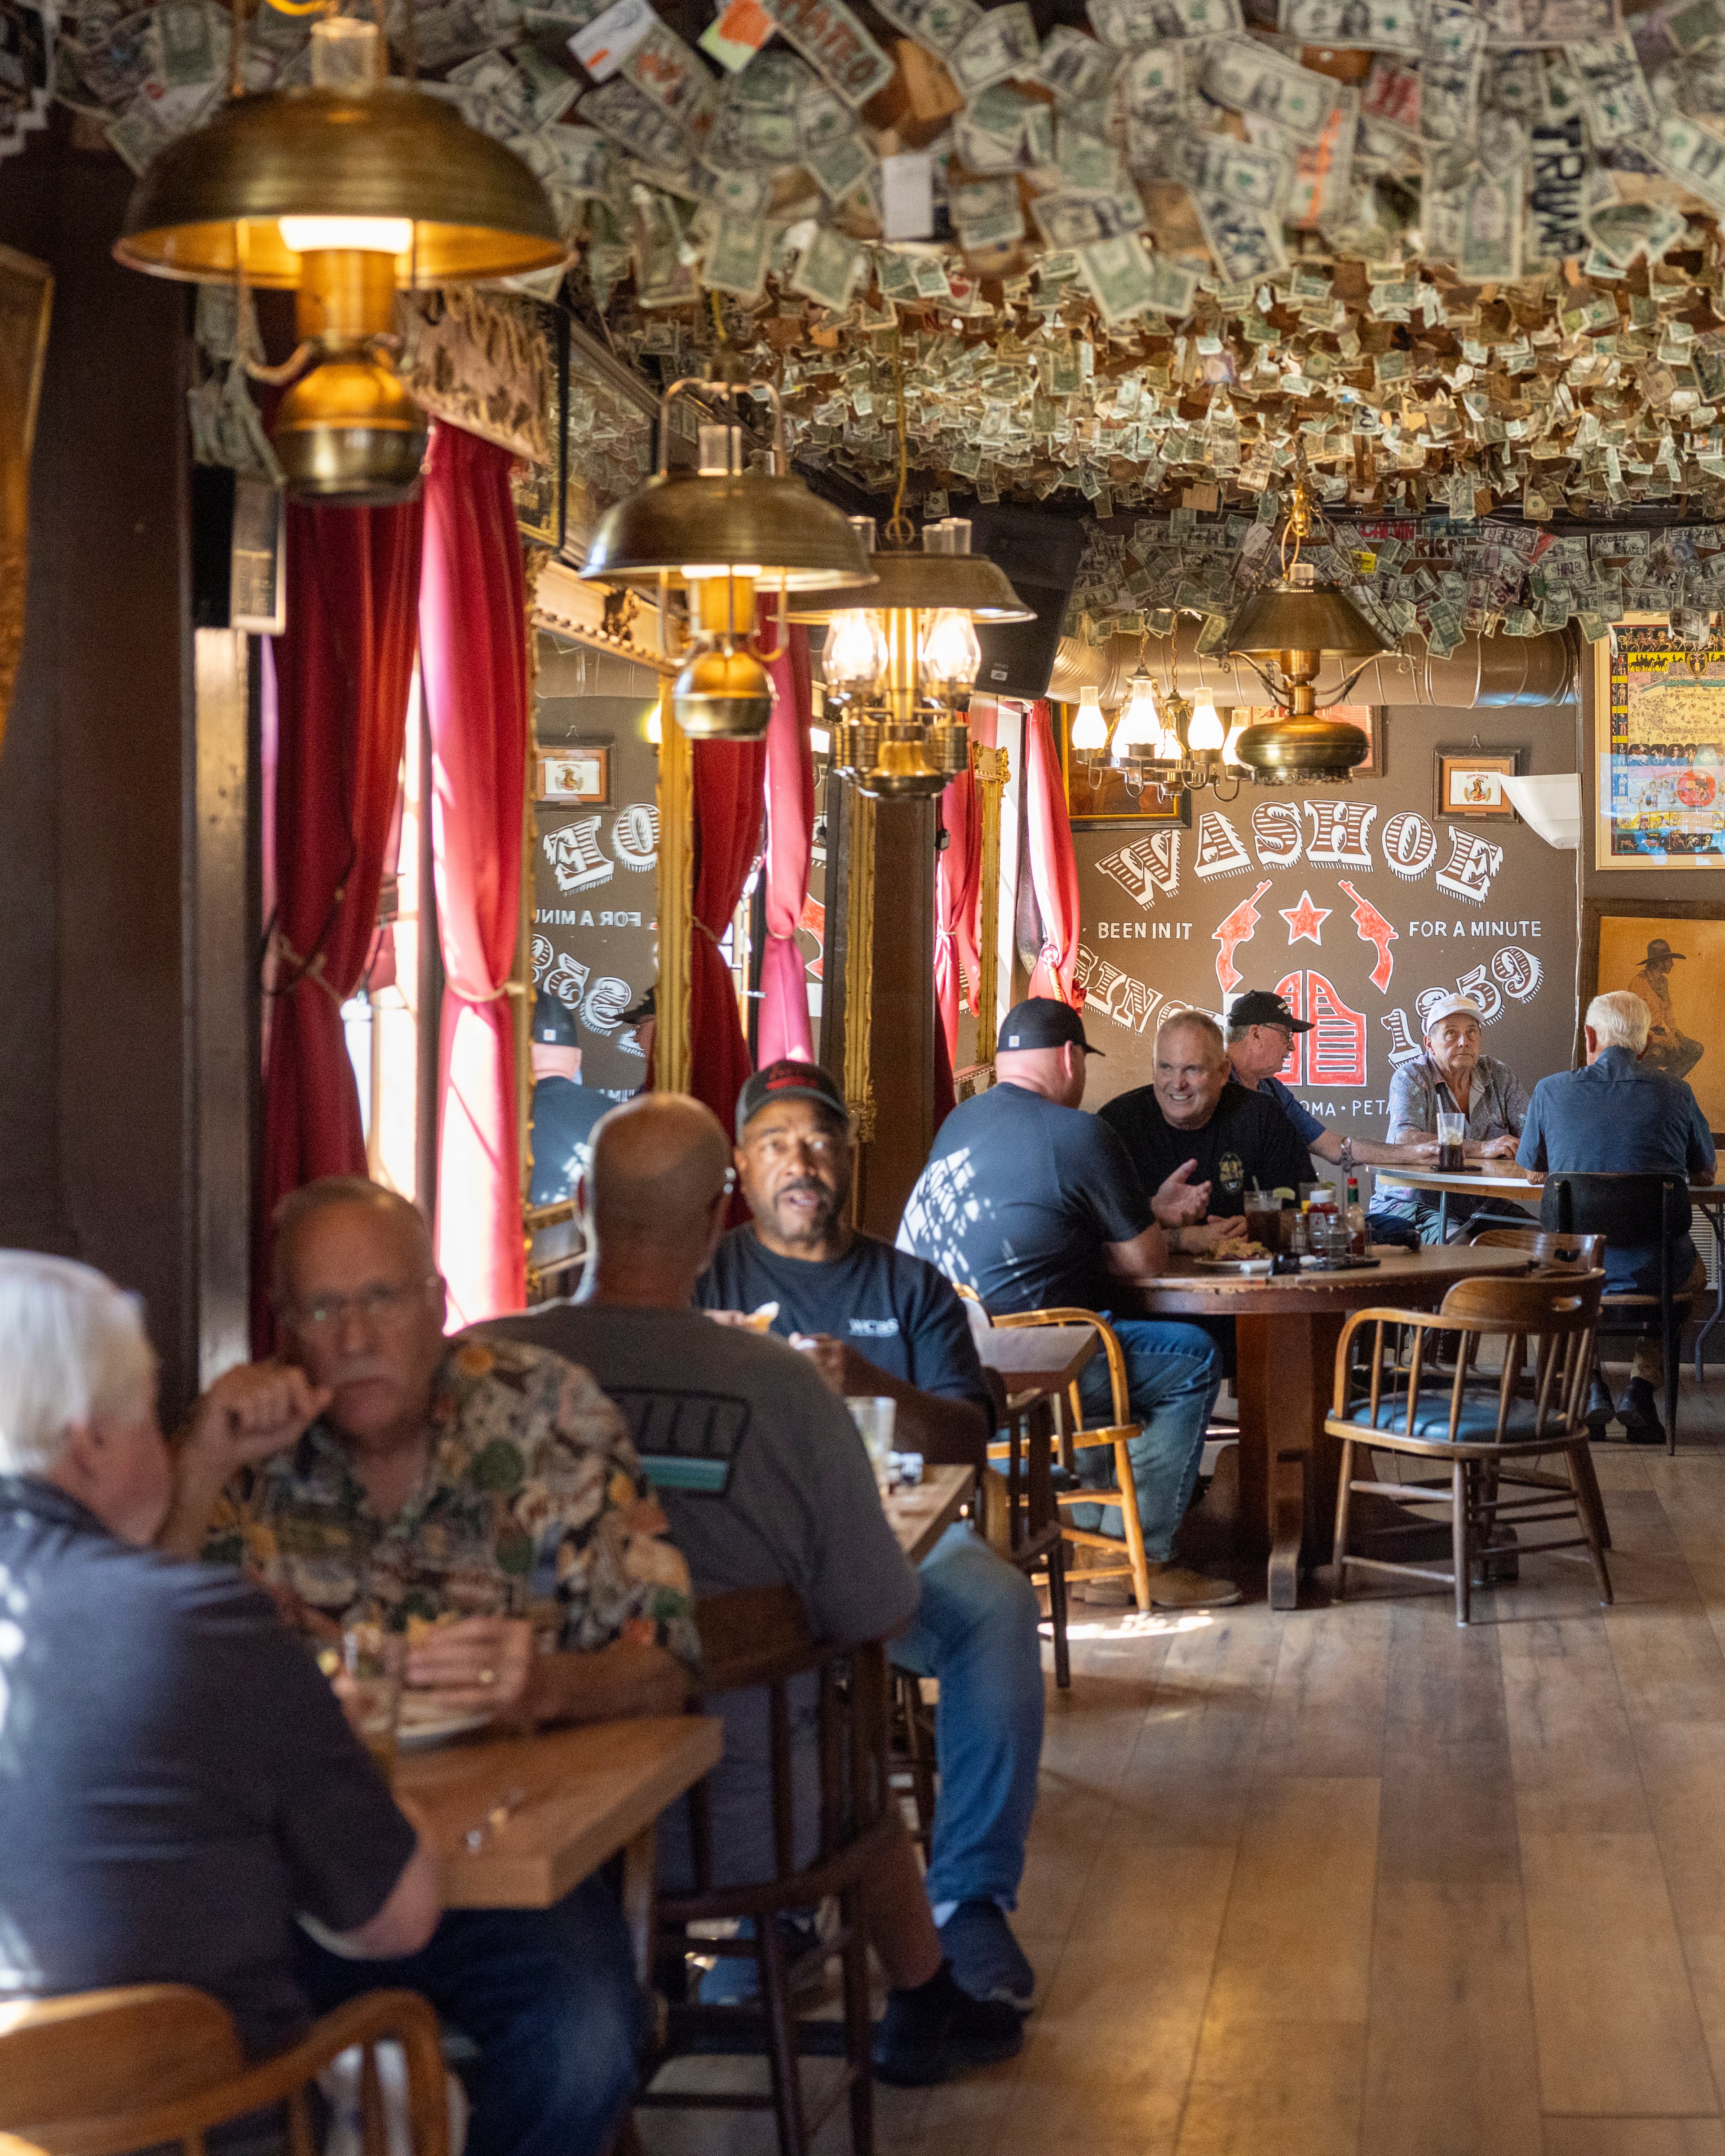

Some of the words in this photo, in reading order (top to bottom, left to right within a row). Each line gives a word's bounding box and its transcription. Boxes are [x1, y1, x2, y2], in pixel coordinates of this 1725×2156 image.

[1094, 799, 1504, 910] WASHOE
[1098, 922, 1146, 938] BEEN
[1152, 923, 1171, 939] IN
[1176, 922, 1193, 940] IT
[1409, 921, 1447, 937] FOR
[1452, 921, 1466, 937] A
[1471, 921, 1541, 937] MINUTE
